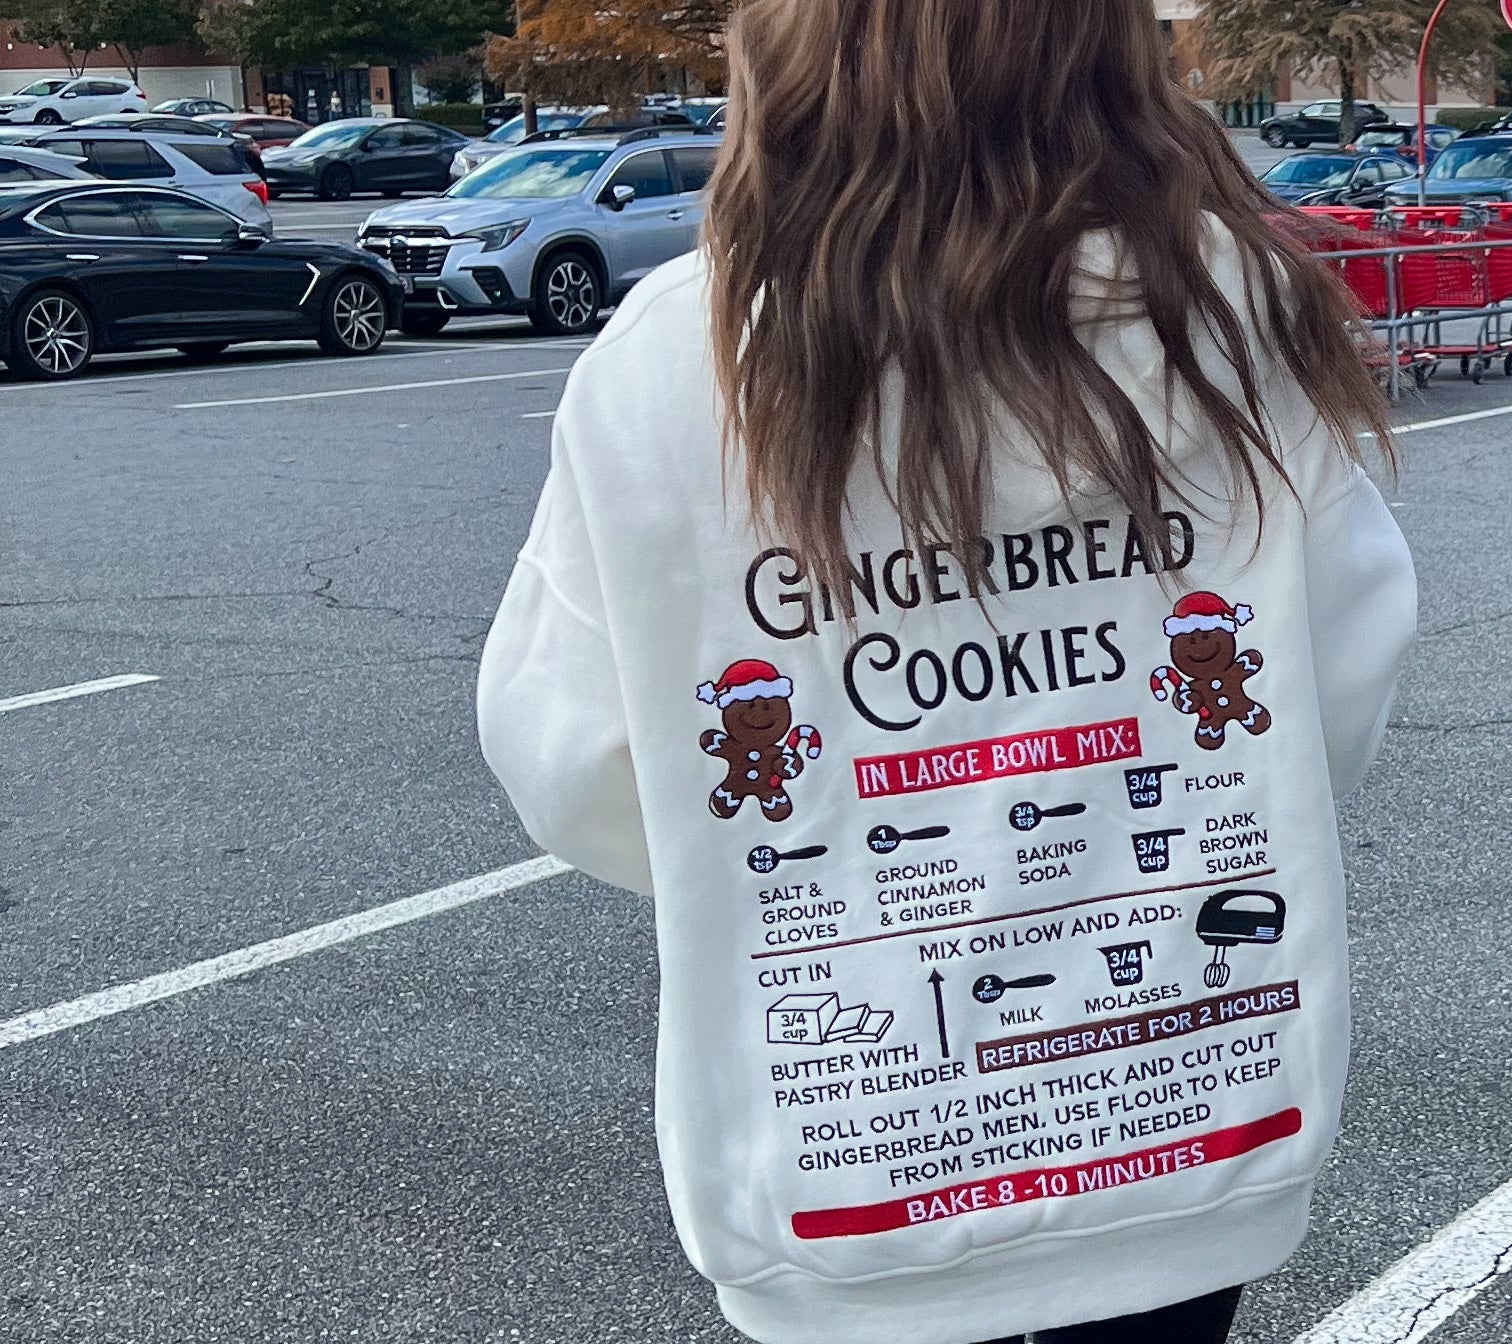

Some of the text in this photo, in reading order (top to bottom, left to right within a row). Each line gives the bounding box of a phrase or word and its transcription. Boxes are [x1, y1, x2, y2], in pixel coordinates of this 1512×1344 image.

[745, 511, 1194, 640] GINGERBREAD
[844, 621, 1126, 731] COOKIES
[861, 725, 1136, 793] IN LARGE BOWL MIX:
[1129, 772, 1159, 790] 3/4
[1185, 772, 1246, 792] FLOUR
[1132, 790, 1158, 803] cup
[1015, 805, 1035, 817] 3/4
[1206, 812, 1257, 833] DARK
[878, 829, 887, 839] 1
[1199, 830, 1269, 854] BROWN
[752, 849, 772, 859] 1/2
[1017, 839, 1087, 864] BAKING
[1136, 837, 1167, 855] 3/4
[753, 860, 774, 872] tsp
[876, 859, 958, 883] GROUND
[1140, 855, 1166, 869] cup
[1206, 851, 1267, 873] SUGAR
[1019, 863, 1072, 885] SODA
[759, 883, 824, 905] SALT &
[878, 875, 986, 905] CINNAMON
[762, 901, 847, 924] GROUND
[880, 899, 974, 926] & GINGER
[765, 923, 839, 945] CLOVES
[919, 905, 1183, 962] MIX ON LOW AND ADD:
[1110, 948, 1140, 968] 3/4
[758, 961, 832, 987] CUT IN
[983, 978, 993, 989] 2
[1113, 967, 1139, 980] cup
[1084, 983, 1183, 1014] MOLASSES
[781, 1012, 807, 1027] 3/4
[1000, 1006, 1044, 1026] MILK
[782, 1028, 808, 1041] cup
[982, 987, 1295, 1068] REFRIGERATE FOR 2 HOURS
[771, 1043, 919, 1081] BUTTER WITH
[775, 1061, 968, 1108] PASTRY BLENDER
[802, 1031, 1278, 1144] ROLL OUT 1/2 INCH THICK AND CUT OUT
[798, 1058, 1281, 1171] GINGERBREAD MEN. USE FLOUR TO KEEP
[889, 1103, 1211, 1187] FROM STICKING IF NEEDED
[907, 1186, 988, 1223] BAKE
[998, 1180, 1016, 1203] 8
[1076, 1142, 1206, 1193] MINUTES
